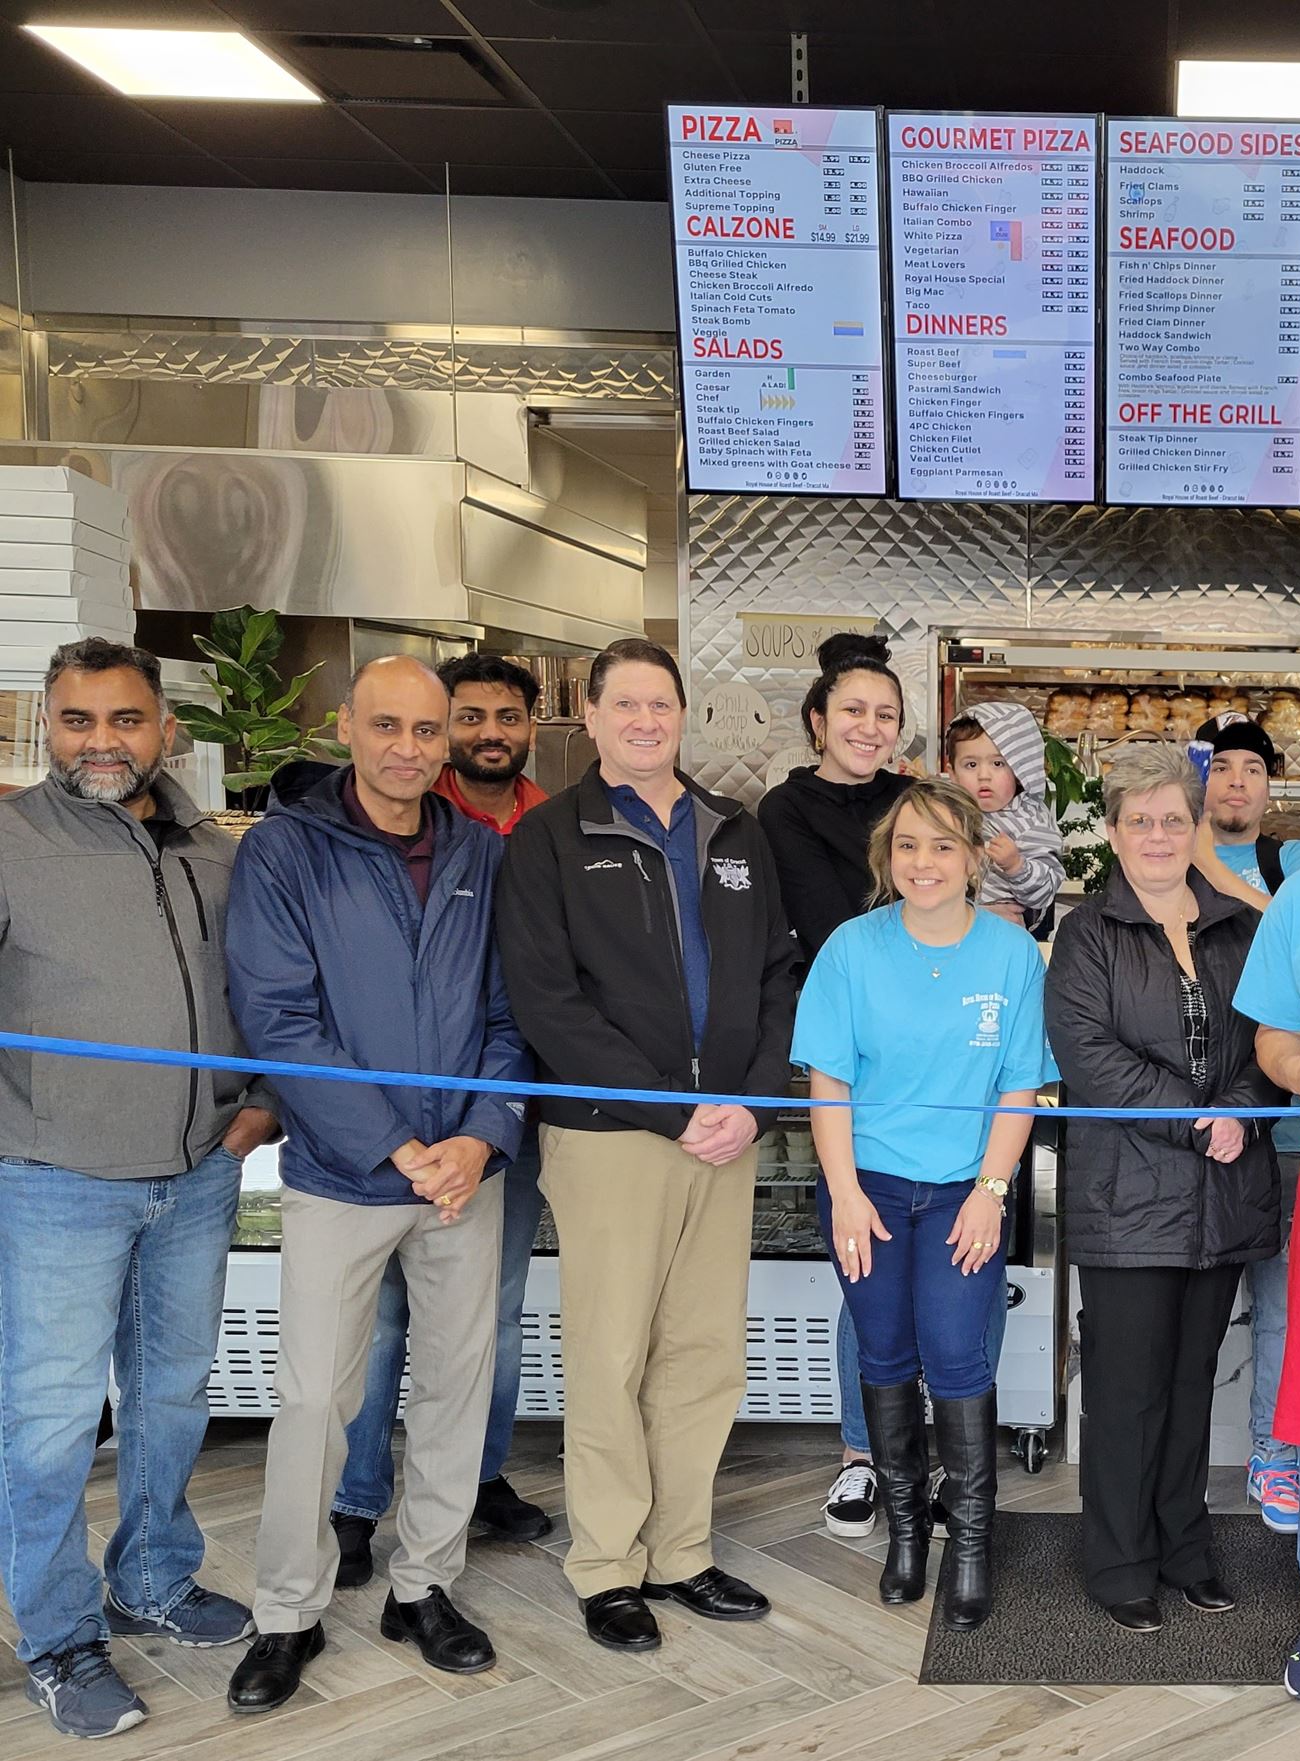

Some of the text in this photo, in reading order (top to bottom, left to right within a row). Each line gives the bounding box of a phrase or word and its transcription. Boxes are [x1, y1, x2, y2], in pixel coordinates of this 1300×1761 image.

[681, 114, 762, 142] PIZZA
[901, 126, 1091, 152] GOURMET PIZZA
[1119, 130, 1234, 155] SEAFOOD
[681, 149, 750, 161] Cheese Pizza
[682, 162, 742, 172] Gluten Free
[900, 159, 1033, 171] Chicken Broccoli Alfredos
[1119, 164, 1165, 174] Haddock
[1147, 180, 1179, 191] Clams
[684, 188, 780, 201] Additional Topping
[902, 187, 949, 199] Hawaiian
[1119, 209, 1155, 220] Shrimp
[686, 214, 795, 239] CALZONE
[902, 216, 972, 227] Italian Combo
[810, 231, 870, 244] $14.99 $21.99
[1119, 225, 1234, 251] SEAFOOD
[903, 244, 959, 256] Vegetarian
[710, 258, 744, 268] Grilled
[745, 259, 787, 270] Chicken
[904, 259, 966, 269] Meat Lovers
[1118, 274, 1225, 285] Fried Haddock Dinner
[690, 315, 751, 326] Steak Bomb
[906, 314, 1008, 336] DINNERS
[692, 336, 783, 360] SALADS
[1117, 341, 1200, 353] Two Way Combo
[694, 368, 731, 378] Garden
[694, 381, 730, 392] Caesar
[1118, 402, 1282, 424] OFF THE GRILL
[909, 466, 1003, 477] Eggplant Parmesan
[1117, 462, 1229, 473] Grilled Chicken Stir Fry
[746, 624, 805, 658] SOUPS
